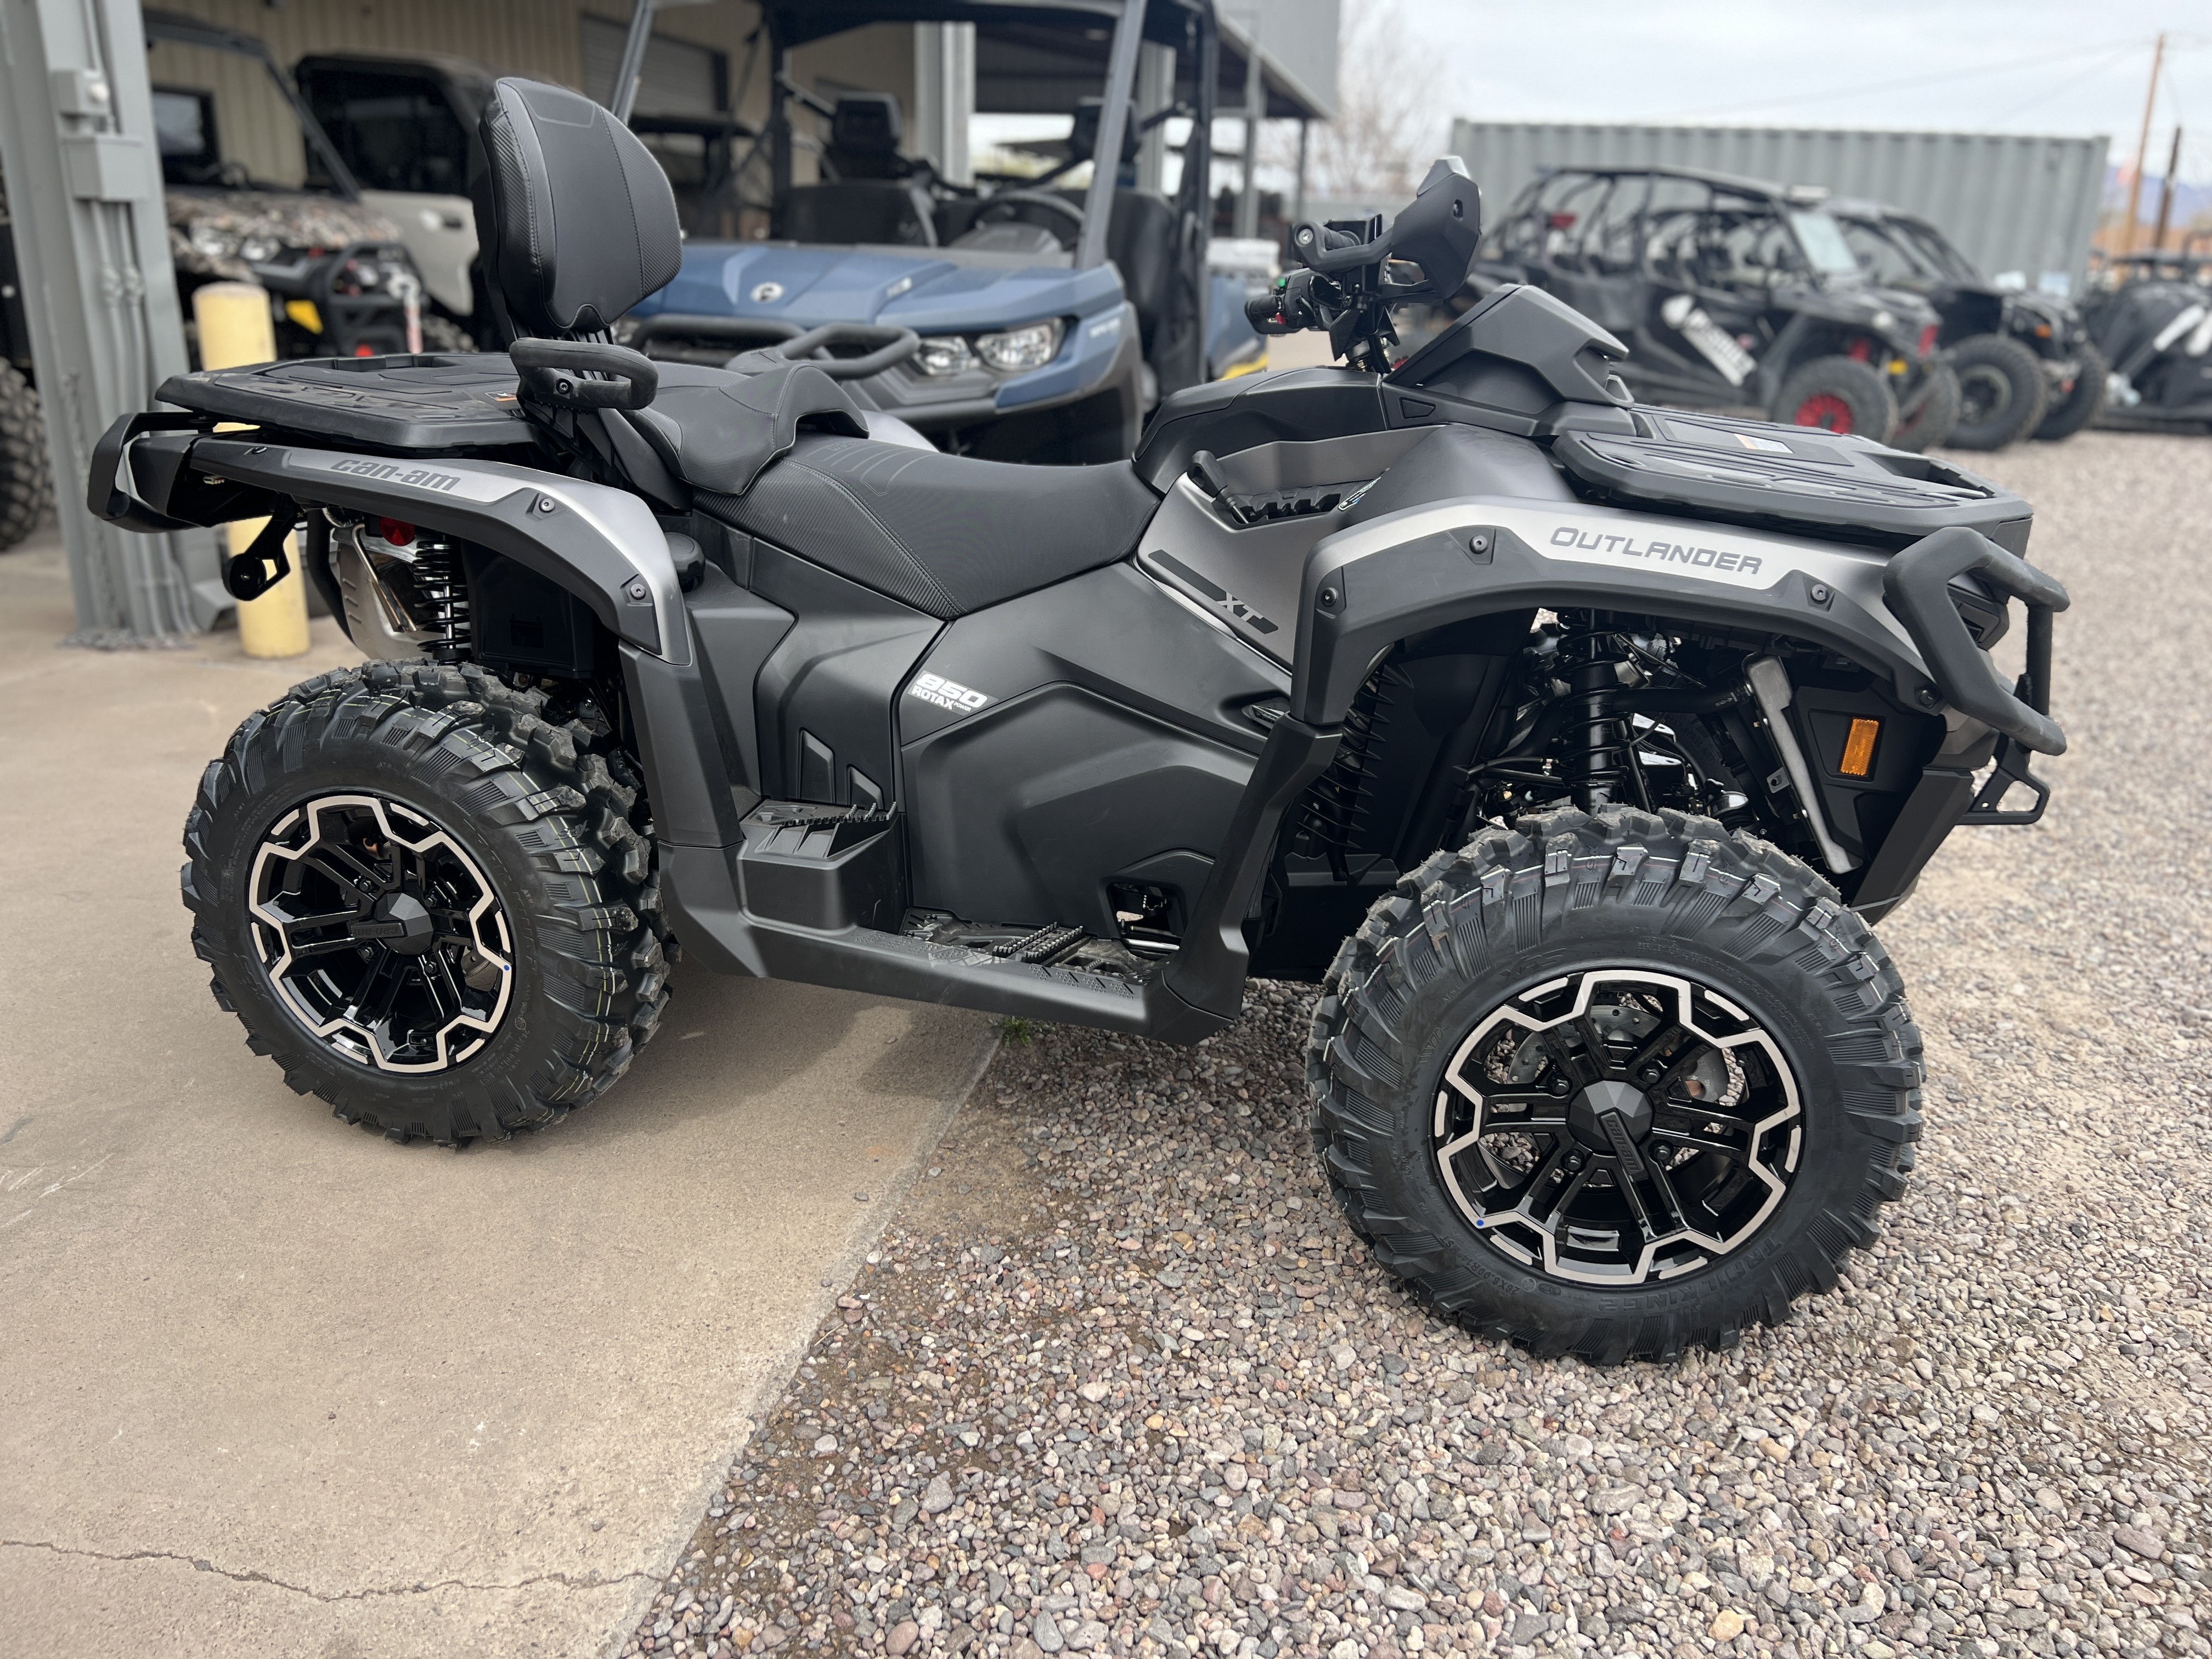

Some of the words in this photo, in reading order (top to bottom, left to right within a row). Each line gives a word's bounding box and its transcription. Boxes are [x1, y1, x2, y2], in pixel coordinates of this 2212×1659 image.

[330, 459, 461, 491] can-am
[1549, 527, 1763, 574] OUTLANDER
[1216, 591, 1263, 622] XT
[911, 685, 955, 710] ROTAX
[953, 701, 972, 712] POWER
[916, 673, 988, 708] 850
[1606, 1119, 1640, 1171] can-am
